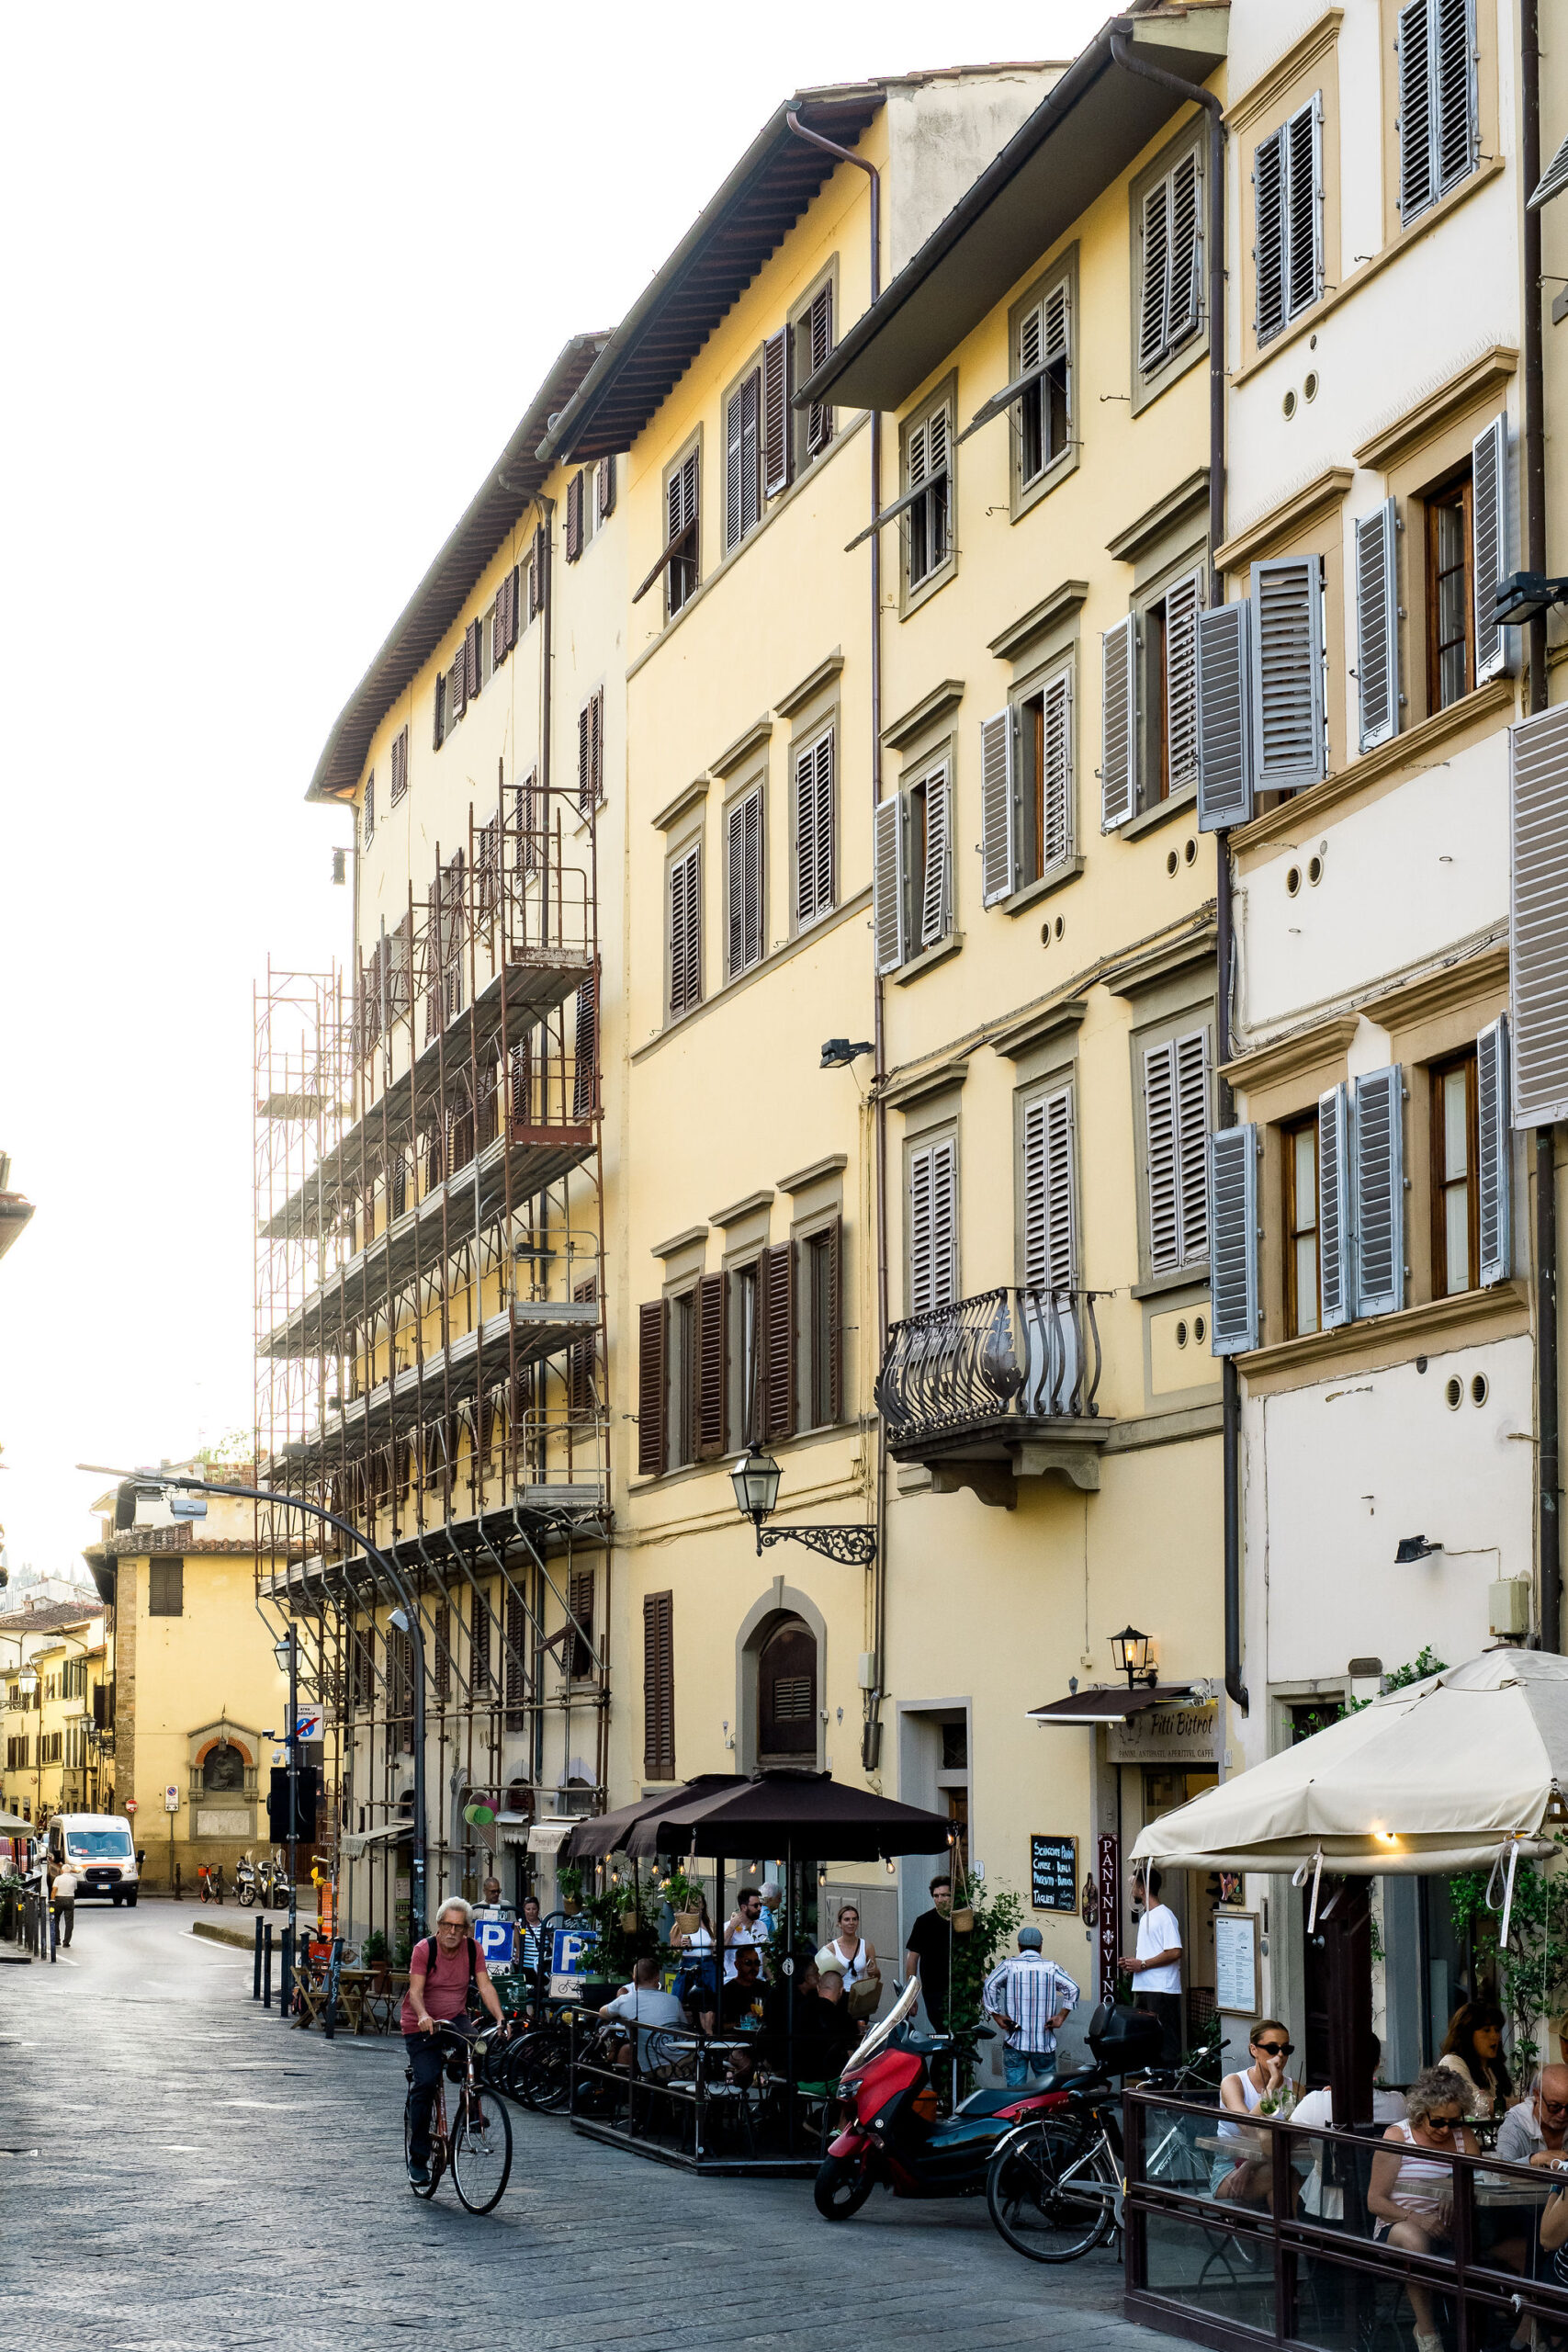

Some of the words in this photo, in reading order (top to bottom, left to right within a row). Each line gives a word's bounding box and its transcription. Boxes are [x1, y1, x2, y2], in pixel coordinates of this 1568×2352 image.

[1151, 1713, 1175, 1736] Pitti
[1177, 1712, 1213, 1736] Bistrot
[1102, 1840, 1114, 1925] PANINI
[481, 1925, 505, 1956] P
[561, 1936, 589, 1971] P
